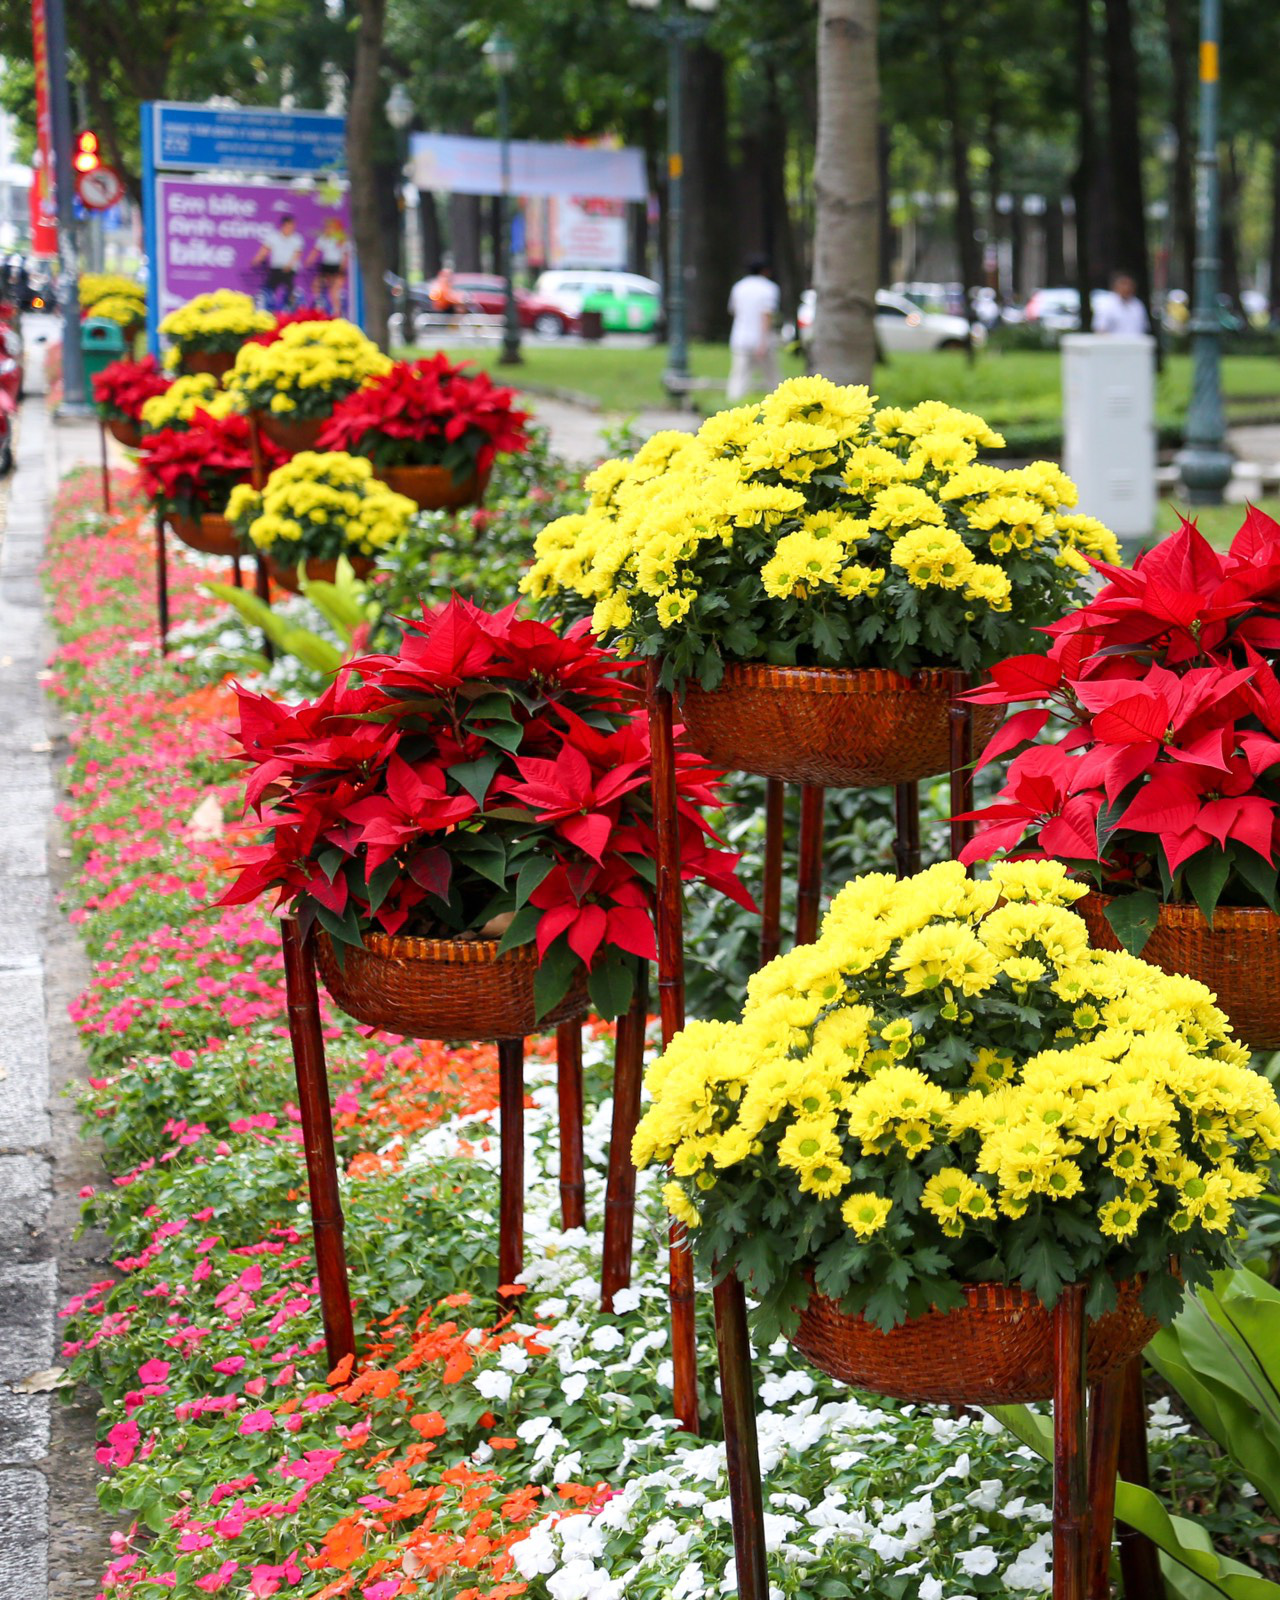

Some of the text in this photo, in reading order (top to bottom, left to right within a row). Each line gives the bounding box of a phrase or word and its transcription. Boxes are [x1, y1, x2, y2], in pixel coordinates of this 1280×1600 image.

[168, 194, 257, 216] Em bike
[169, 238, 236, 267] bike
